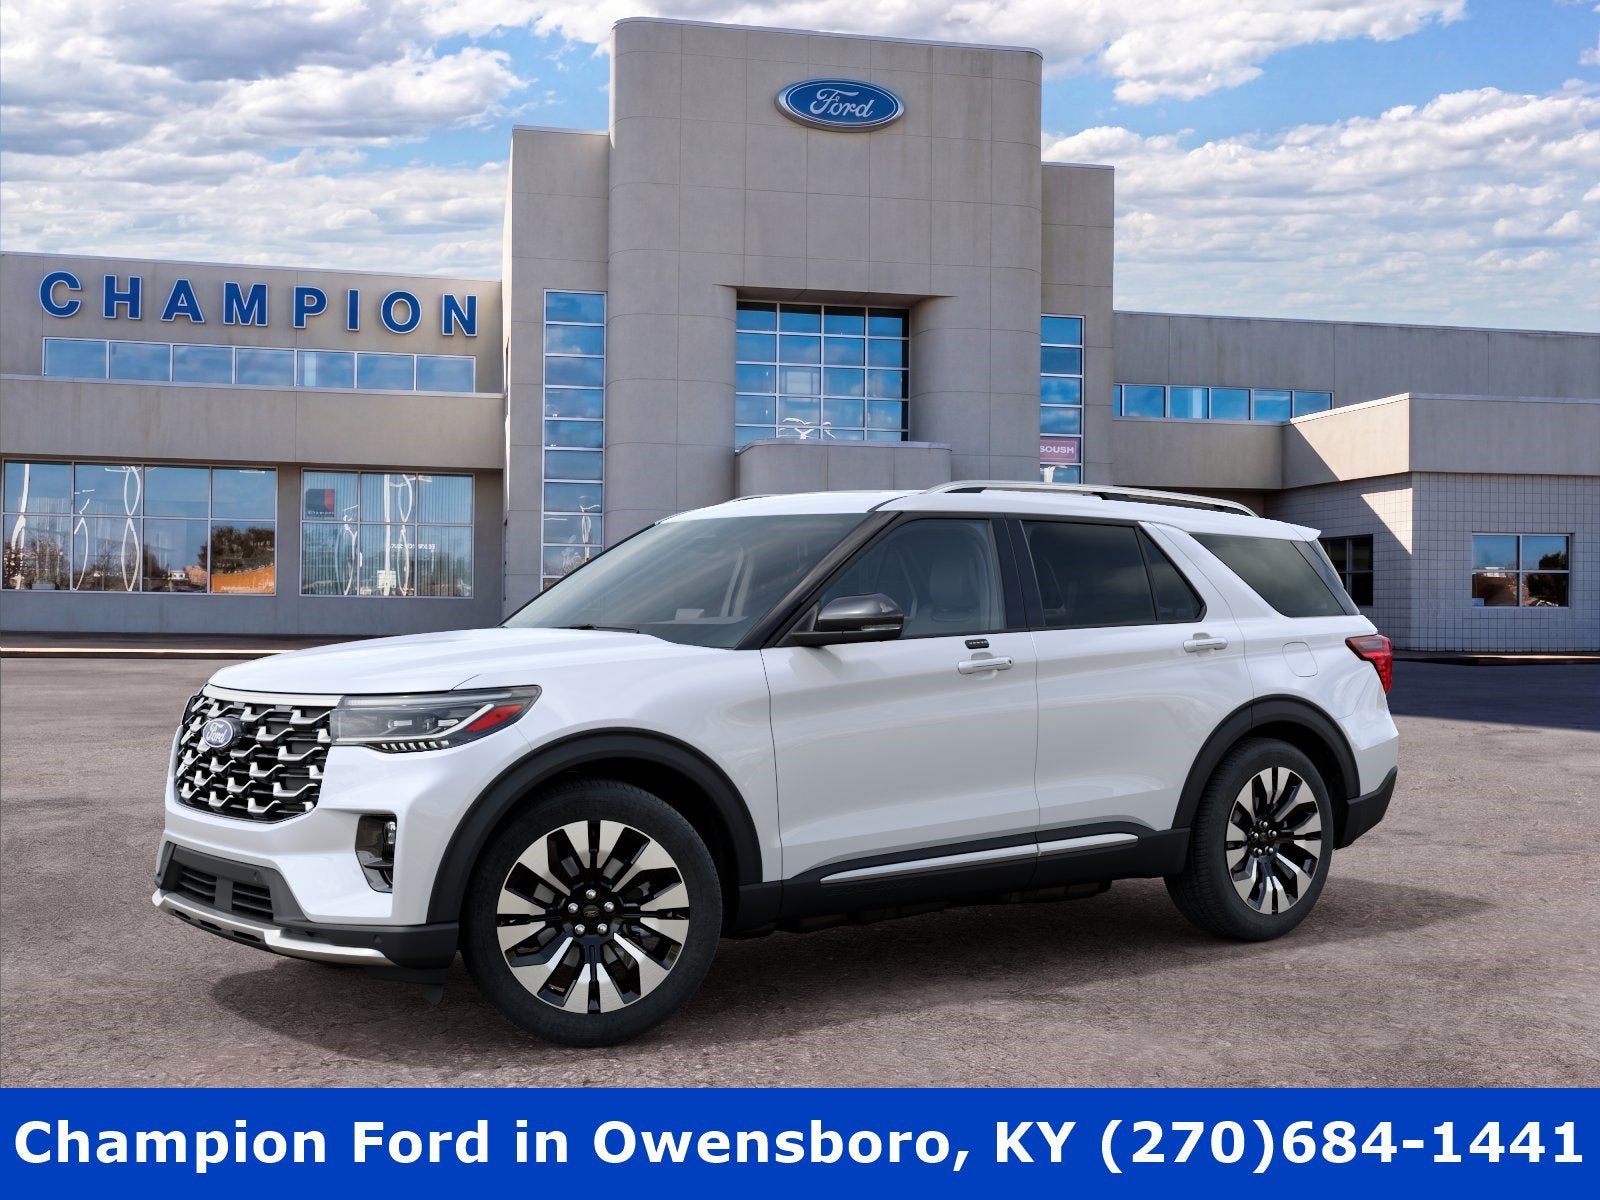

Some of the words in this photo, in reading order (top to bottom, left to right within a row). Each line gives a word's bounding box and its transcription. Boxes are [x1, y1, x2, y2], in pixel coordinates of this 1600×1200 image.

[809, 88, 876, 118] Ford
[39, 270, 479, 337] CHAMPION
[206, 721, 228, 744] Ford
